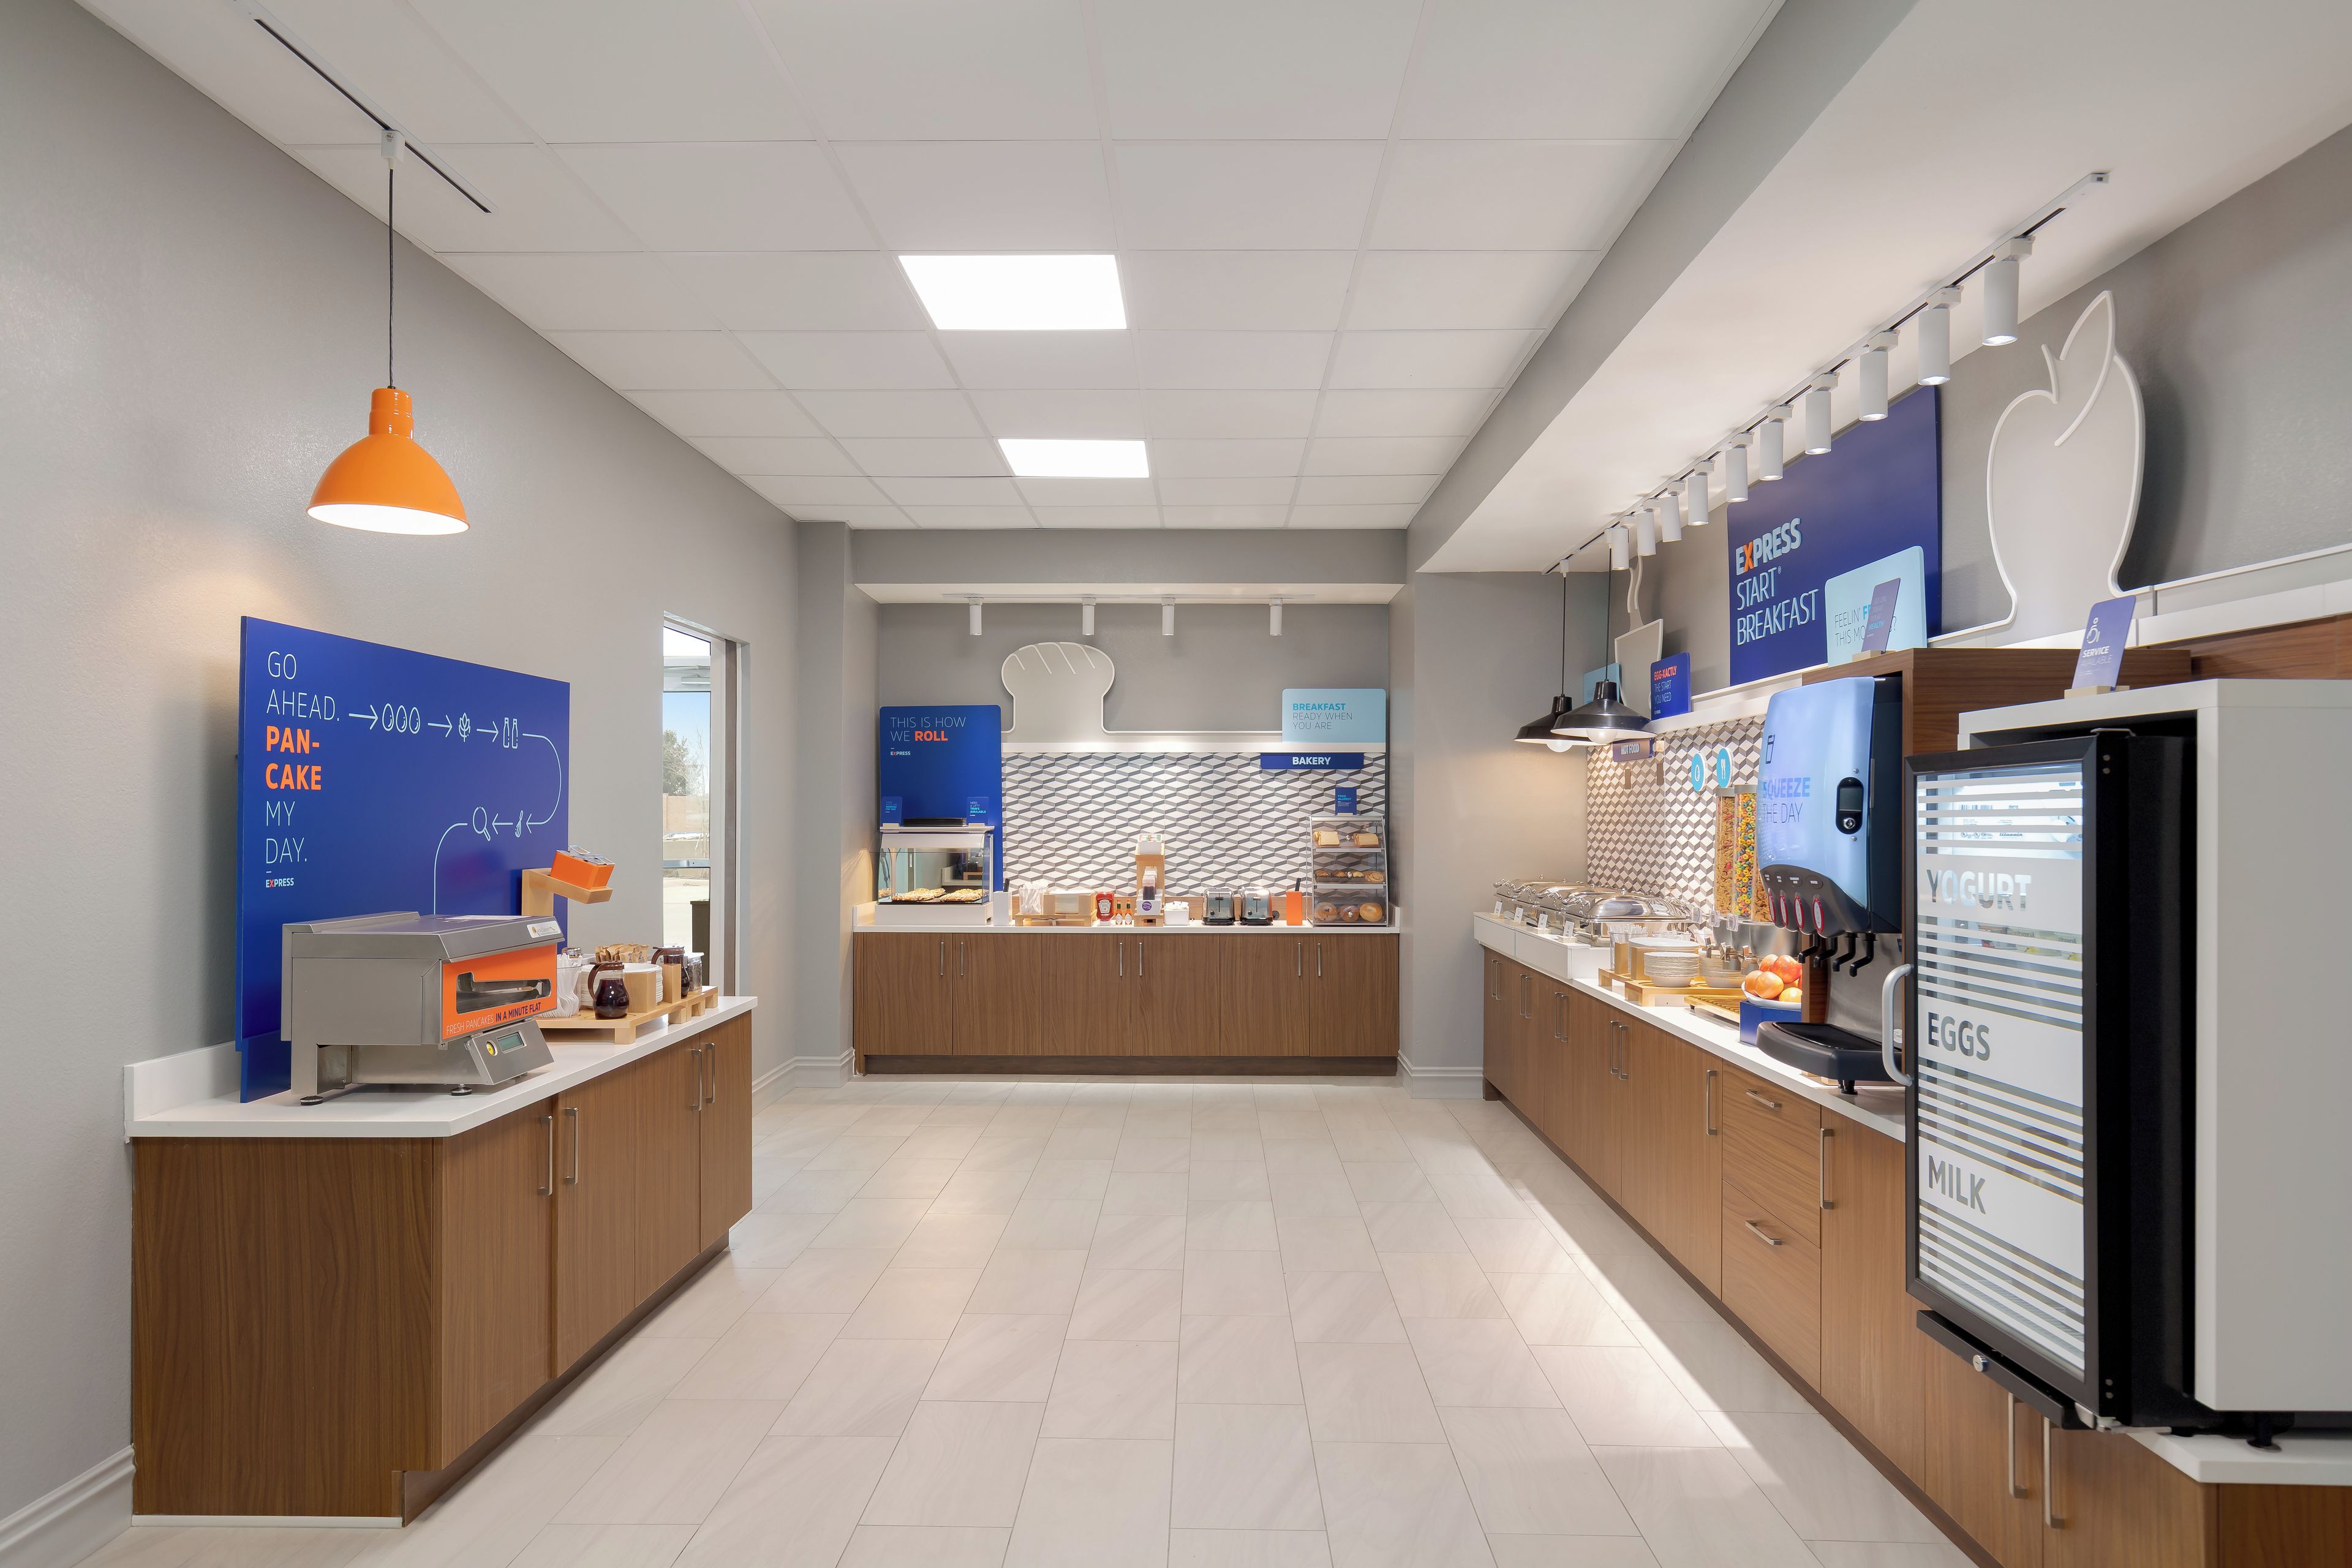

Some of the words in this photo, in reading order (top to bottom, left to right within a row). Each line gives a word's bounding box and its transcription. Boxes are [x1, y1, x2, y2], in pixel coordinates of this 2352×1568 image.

[1736, 518, 1801, 575] EXPRESS
[1737, 589, 1819, 646] BREAKFAST
[1834, 608, 1861, 629] FEELIN'
[1835, 630, 1852, 647] THIS
[2082, 646, 2110, 658] SERVICE
[268, 650, 296, 680] GO
[1654, 665, 1677, 681] EGG-XACTLY
[1661, 680, 1672, 691] START
[266, 688, 339, 722] AHEAD.
[1662, 692, 1672, 703] NEED
[890, 717, 916, 728] THIS
[921, 717, 931, 728] IS
[935, 717, 966, 728] HOW
[266, 725, 320, 755] PAN-
[890, 731, 910, 742] WE
[914, 730, 948, 742] ROLL
[1292, 756, 1331, 765] BAKERY
[1621, 745, 1629, 755] HOT
[1629, 743, 1640, 754] FOOD
[266, 763, 322, 791] CAKE
[1763, 777, 1811, 800] SQUEEZE
[266, 801, 295, 827] MY
[1762, 803, 1777, 823] THE
[1781, 802, 1803, 823] DAY
[266, 837, 307, 864] DAY.
[266, 878, 294, 888] EXPRESS
[1926, 869, 2032, 911] YOGURT
[446, 1022, 464, 1036] FRESH
[466, 1014, 494, 1029] PANCAKES
[496, 1012, 502, 1022] IN
[503, 1011, 507, 1020] A
[508, 1005, 528, 1019] MINUTE
[529, 1002, 541, 1012] FLAT
[1928, 1012, 1990, 1061] EGGS
[1929, 1155, 1986, 1215] MILK
